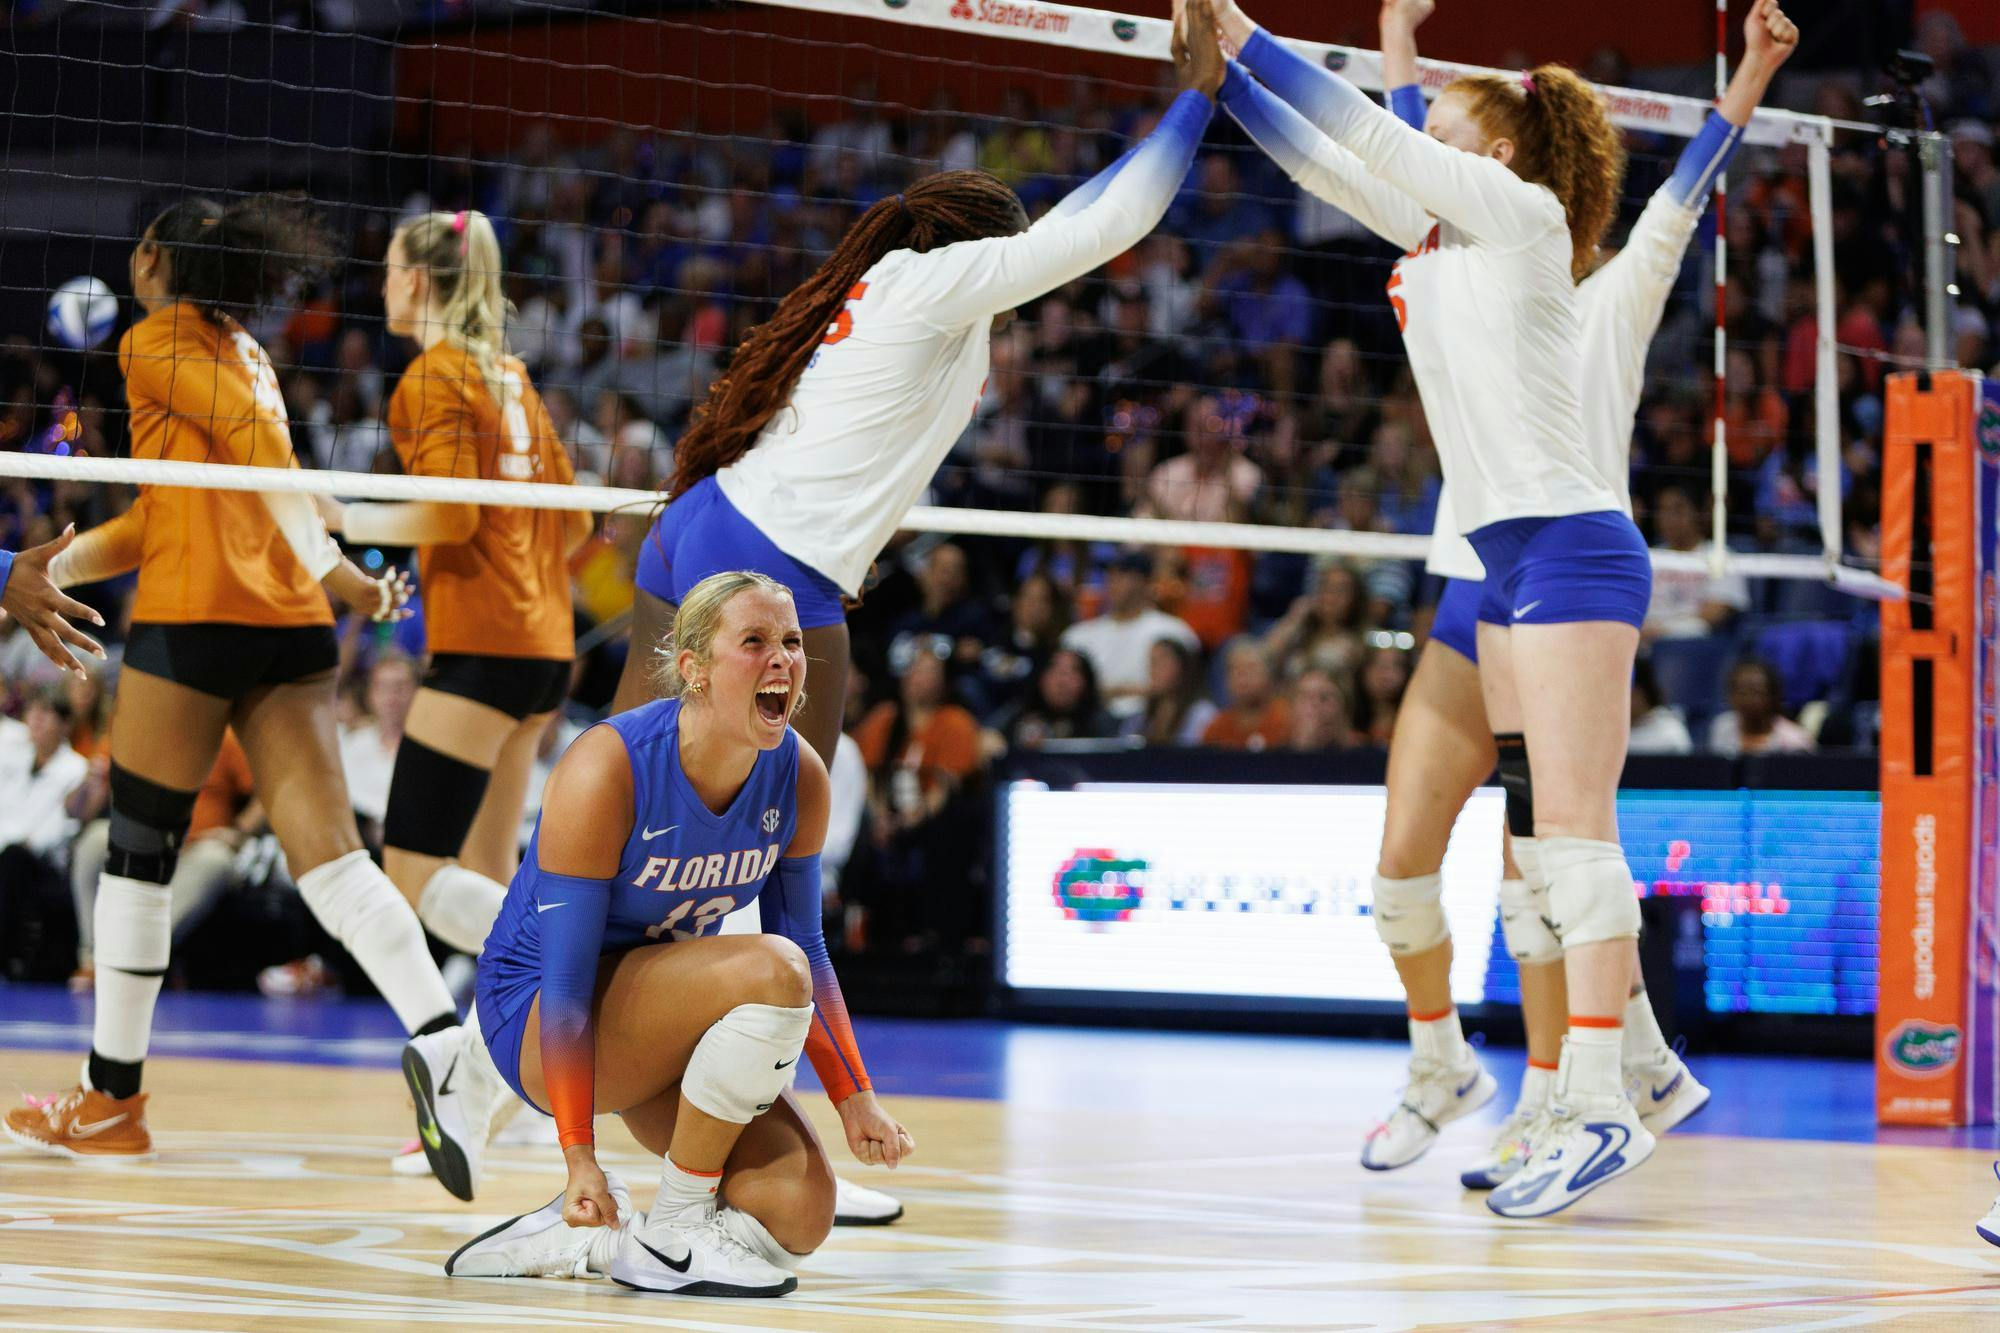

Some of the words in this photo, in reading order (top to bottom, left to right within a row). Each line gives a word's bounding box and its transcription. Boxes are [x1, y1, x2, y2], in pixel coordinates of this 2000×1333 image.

[762, 808, 780, 833] SEC
[631, 843, 780, 892] FLORIDA
[1913, 814, 1937, 896] sports
